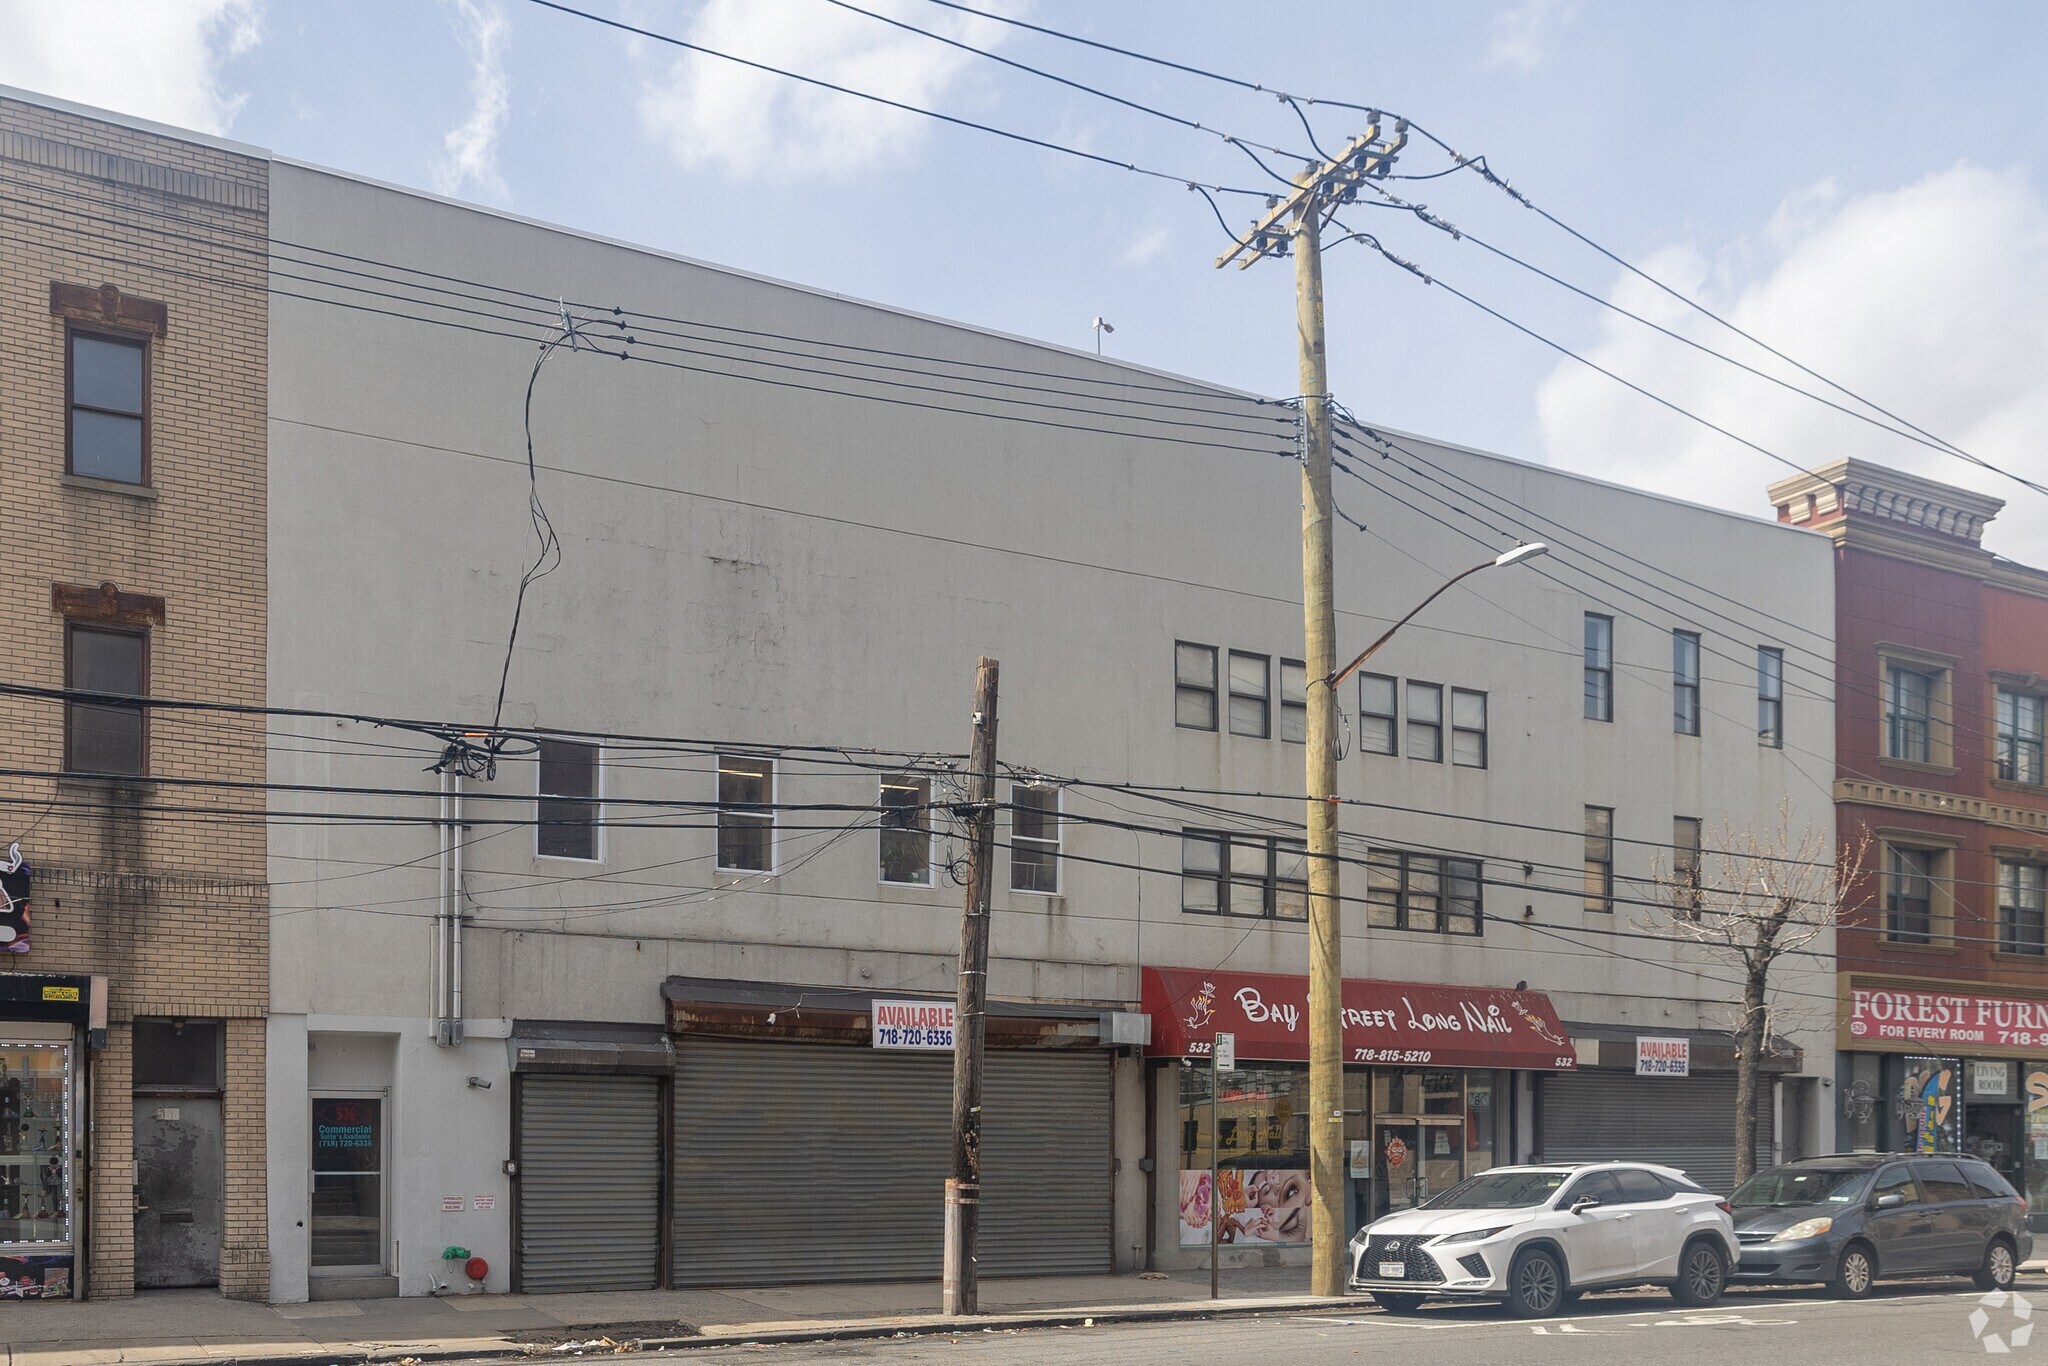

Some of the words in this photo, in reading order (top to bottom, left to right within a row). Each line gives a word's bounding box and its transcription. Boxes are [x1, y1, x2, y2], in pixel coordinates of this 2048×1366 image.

[1306, 992, 1397, 1031] TREET
[1852, 990, 1969, 1026] FOREST
[877, 1006, 954, 1027] AVAILABLE
[1852, 1023, 1866, 1034] 526
[1880, 1025, 1905, 1038] FOR
[1908, 1027, 1947, 1040] EVERY
[1950, 1029, 1984, 1042] ROOM
[879, 1029, 952, 1046] 718-720-6336
[1189, 1042, 1211, 1053] 532
[1640, 1042, 1687, 1059] AVAILABLE
[1354, 1048, 1431, 1063] 718-815-5210
[1555, 1057, 1573, 1067] 532
[1640, 1060, 1686, 1073] 718-720-6336
[1976, 1065, 2006, 1077] LIVING
[1979, 1079, 2003, 1091] ROOM
[319, 1125, 372, 1134] Commercial
[319, 1140, 338, 1148] (718)
